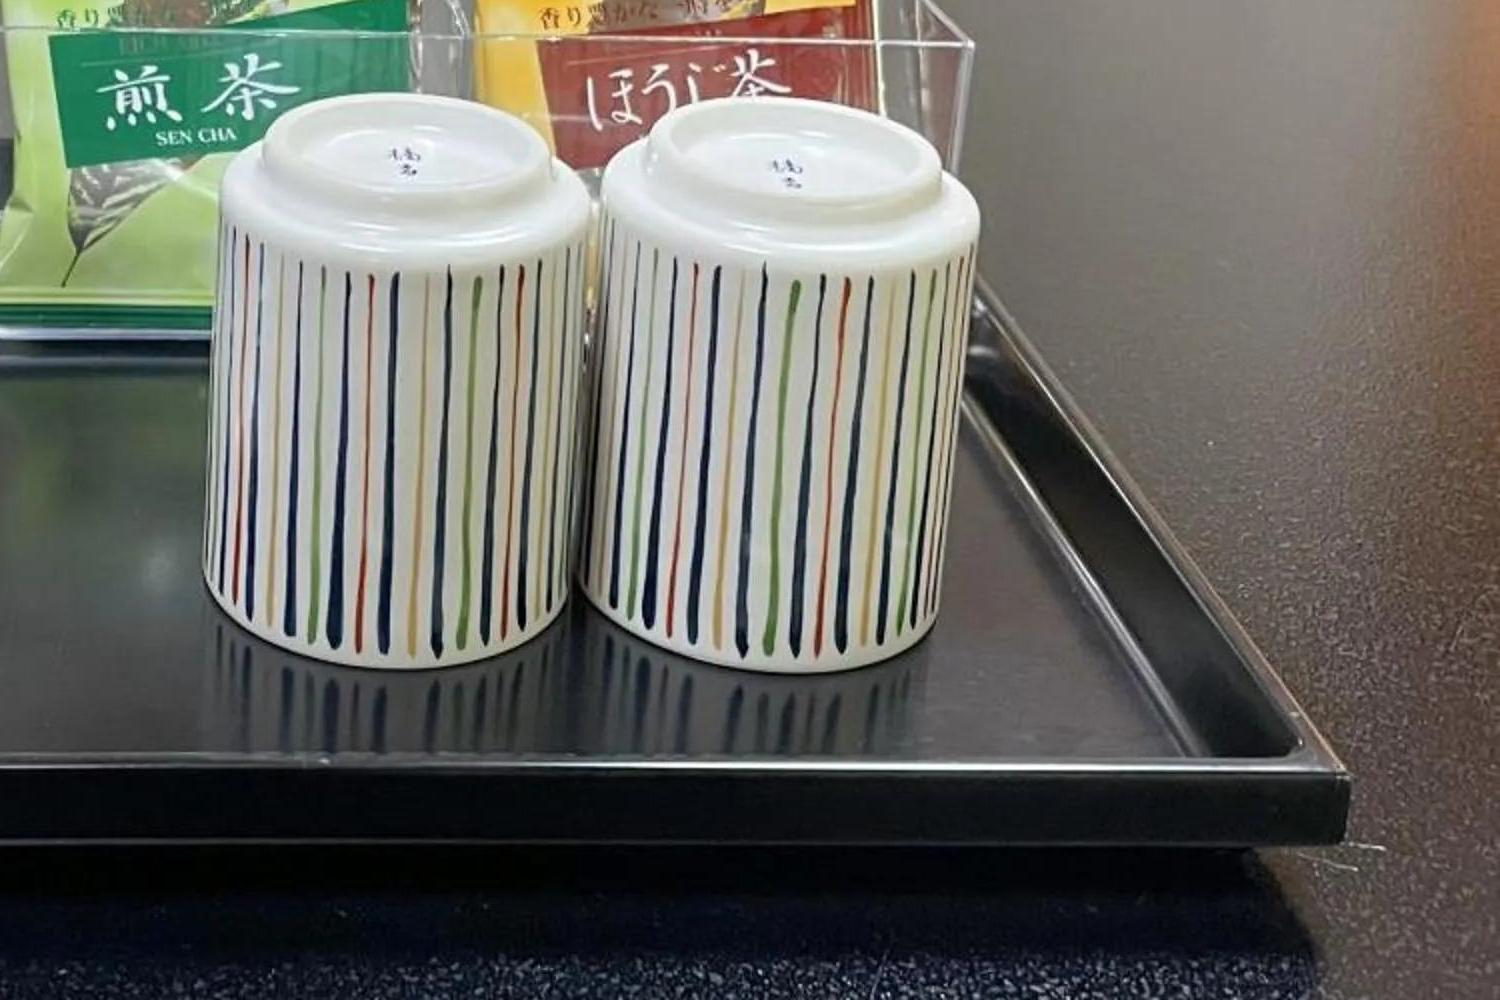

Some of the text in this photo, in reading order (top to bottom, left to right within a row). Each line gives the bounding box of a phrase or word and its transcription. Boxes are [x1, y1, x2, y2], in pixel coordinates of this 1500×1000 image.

[96, 52, 301, 131] 煎茶
[586, 48, 793, 132] ほうじ茶
[155, 127, 238, 147] SEN CHA
